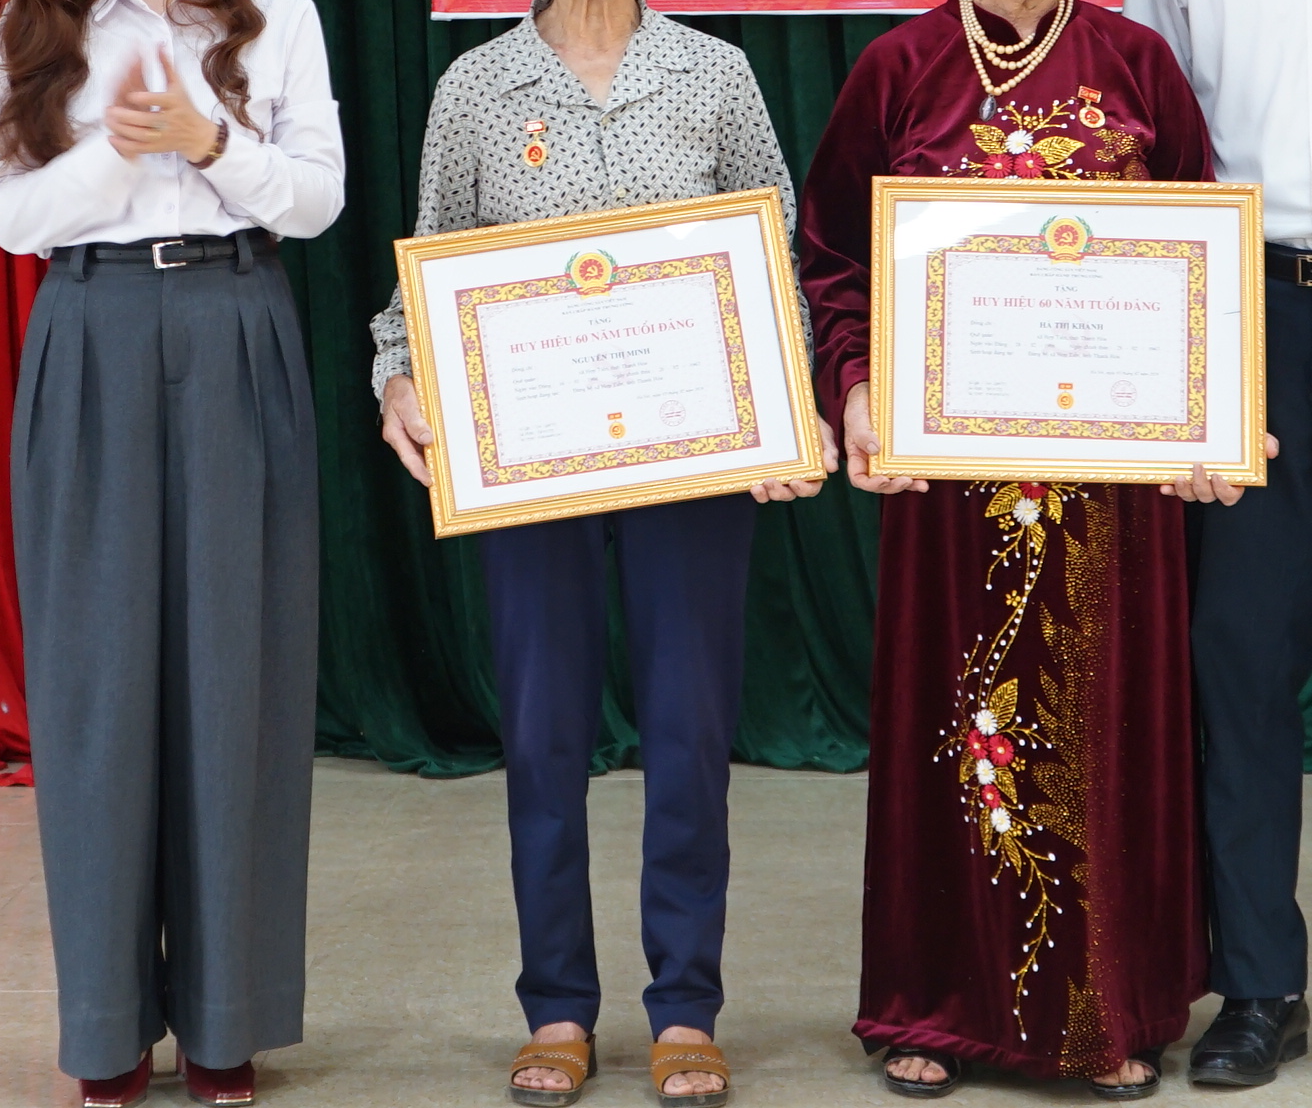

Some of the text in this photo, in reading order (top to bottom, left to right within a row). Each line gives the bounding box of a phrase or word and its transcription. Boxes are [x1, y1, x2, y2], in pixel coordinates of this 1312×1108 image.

[973, 296, 1161, 312] HUY HIỆU 60 NĂM TUỔI ĐẢNG
[510, 318, 695, 354] HUY HIỆU 60 NĂM TUỔI ĐẢNG
[627, 347, 650, 358] MINH
